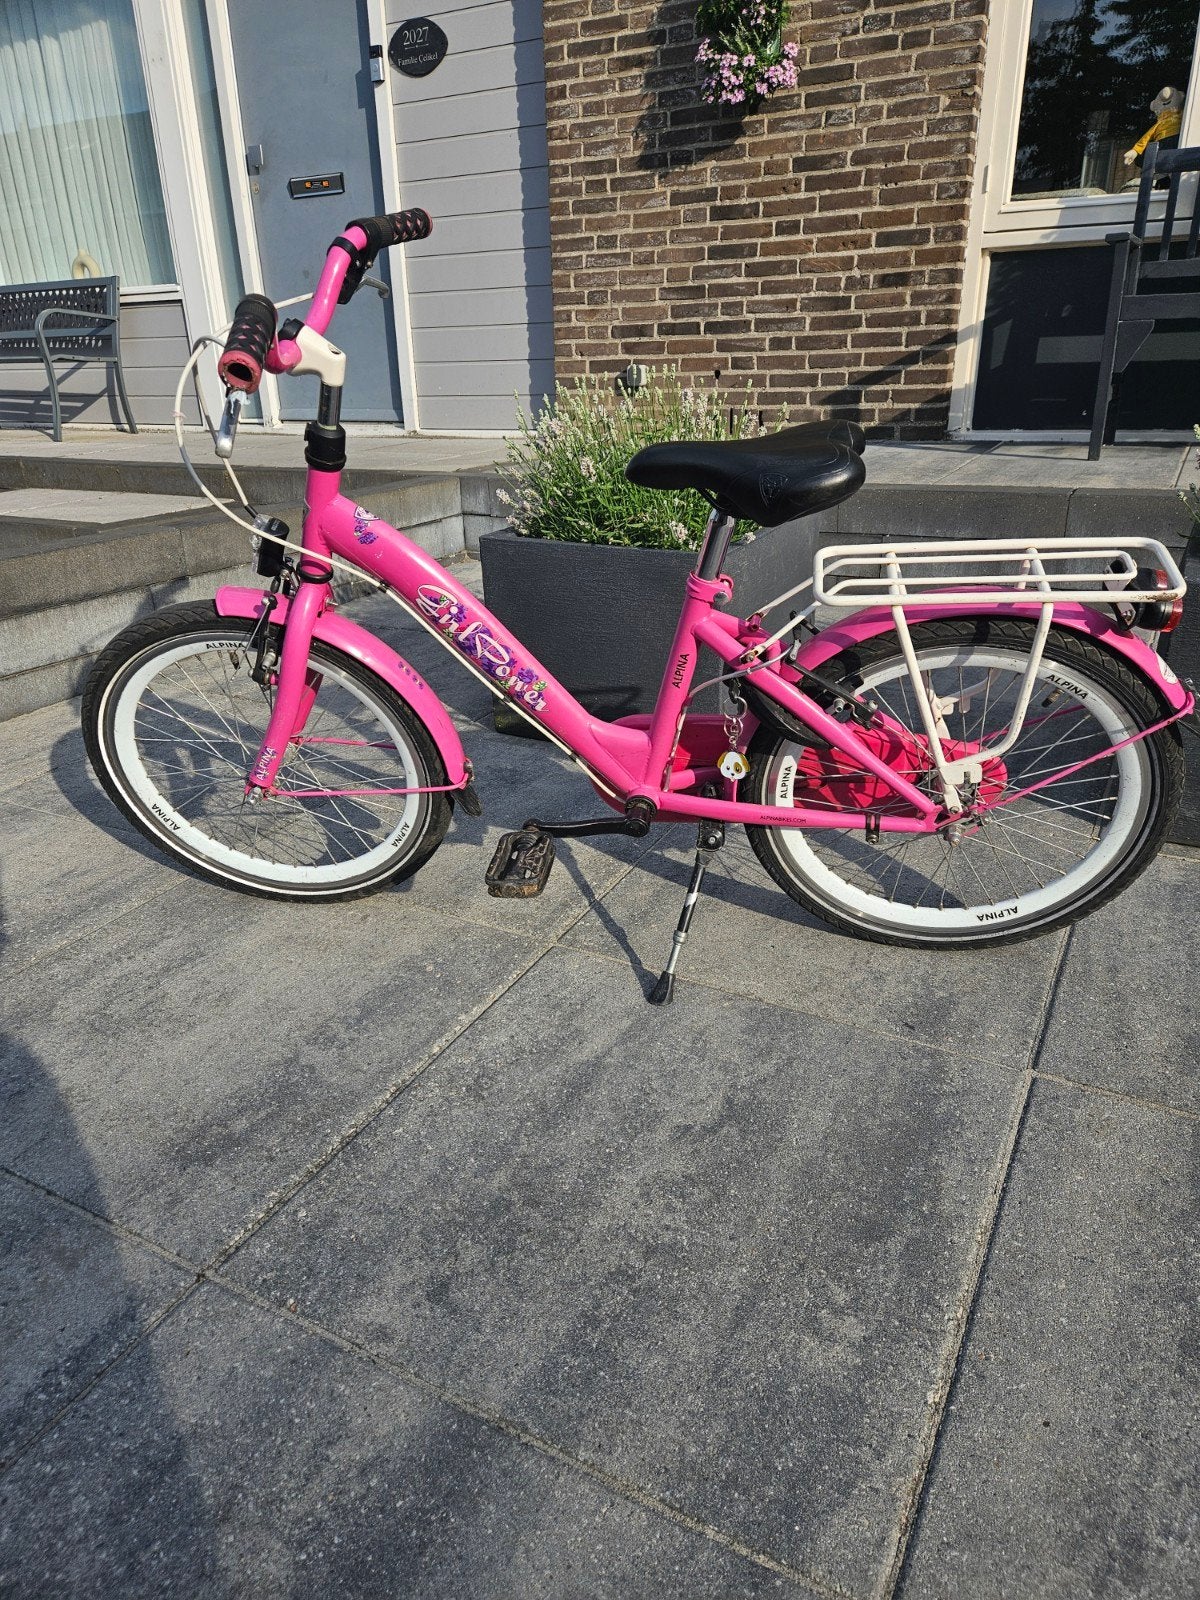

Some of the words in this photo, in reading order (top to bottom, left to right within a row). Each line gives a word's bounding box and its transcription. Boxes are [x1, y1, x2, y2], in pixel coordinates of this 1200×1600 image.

[402, 26, 429, 46] 2027
[397, 56, 418, 67] Familie
[205, 641, 247, 650] ALPINA
[415, 584, 482, 643] Girl
[475, 632, 549, 712] Power
[671, 653, 690, 689] ALPINA
[1045, 674, 1088, 700] ALPINA
[256, 747, 276, 780] ALPINA
[780, 765, 793, 799] ALPINA
[151, 803, 181, 830] ALPINA
[391, 821, 410, 847] ALPINA
[976, 906, 1018, 921] ALPINA
